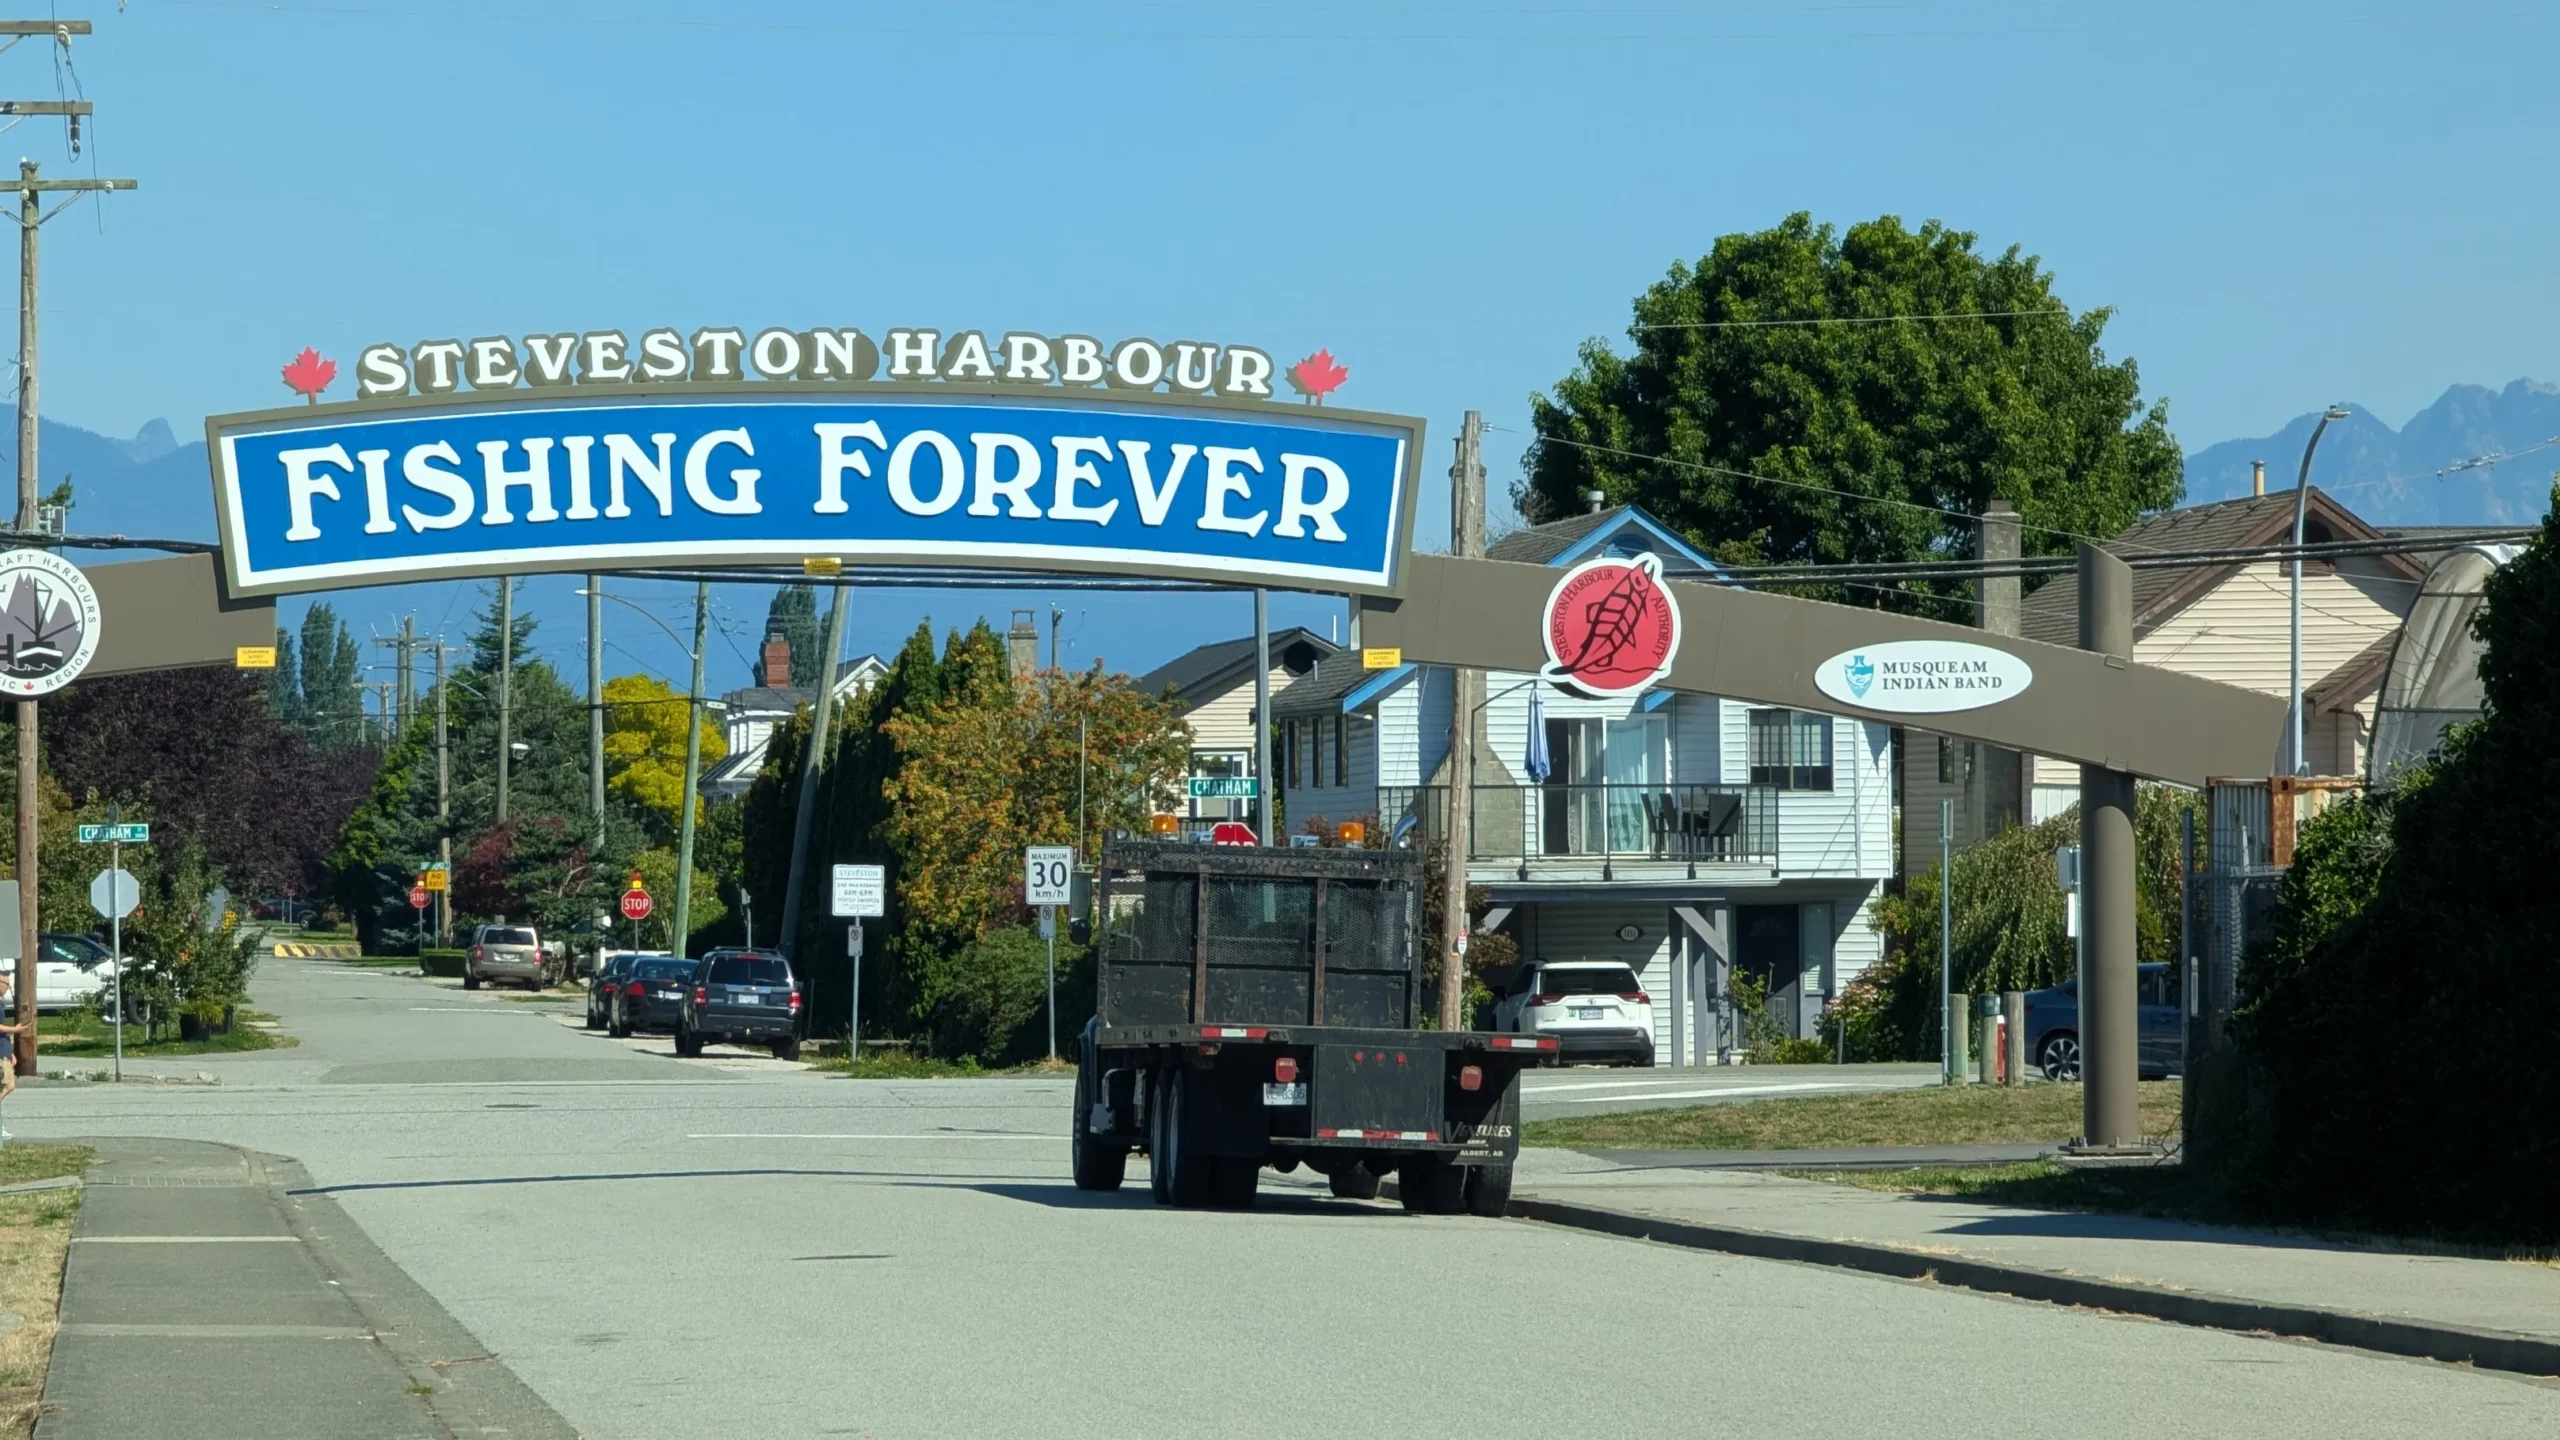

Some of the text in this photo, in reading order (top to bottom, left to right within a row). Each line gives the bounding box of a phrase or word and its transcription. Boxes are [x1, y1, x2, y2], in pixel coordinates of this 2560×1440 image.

[363, 331, 1272, 395] STEVESTON HARBOUR
[278, 420, 1350, 543] FISHING FOREVER
[42, 556, 97, 624] HARBOURS
[1554, 569, 1671, 661] STEVESTON HARBOUR AUTHORITY
[45, 649, 90, 688] REGION
[1882, 661, 1988, 676] MUSQUEAM
[1882, 676, 2003, 690] INDIAN BAND
[1195, 780, 1251, 795] CHATHAM
[85, 827, 132, 839] CHATHAM
[1032, 861, 1067, 888] 30
[411, 893, 430, 901] STOP
[1036, 889, 1064, 898] km/h
[624, 898, 649, 910] STOP
